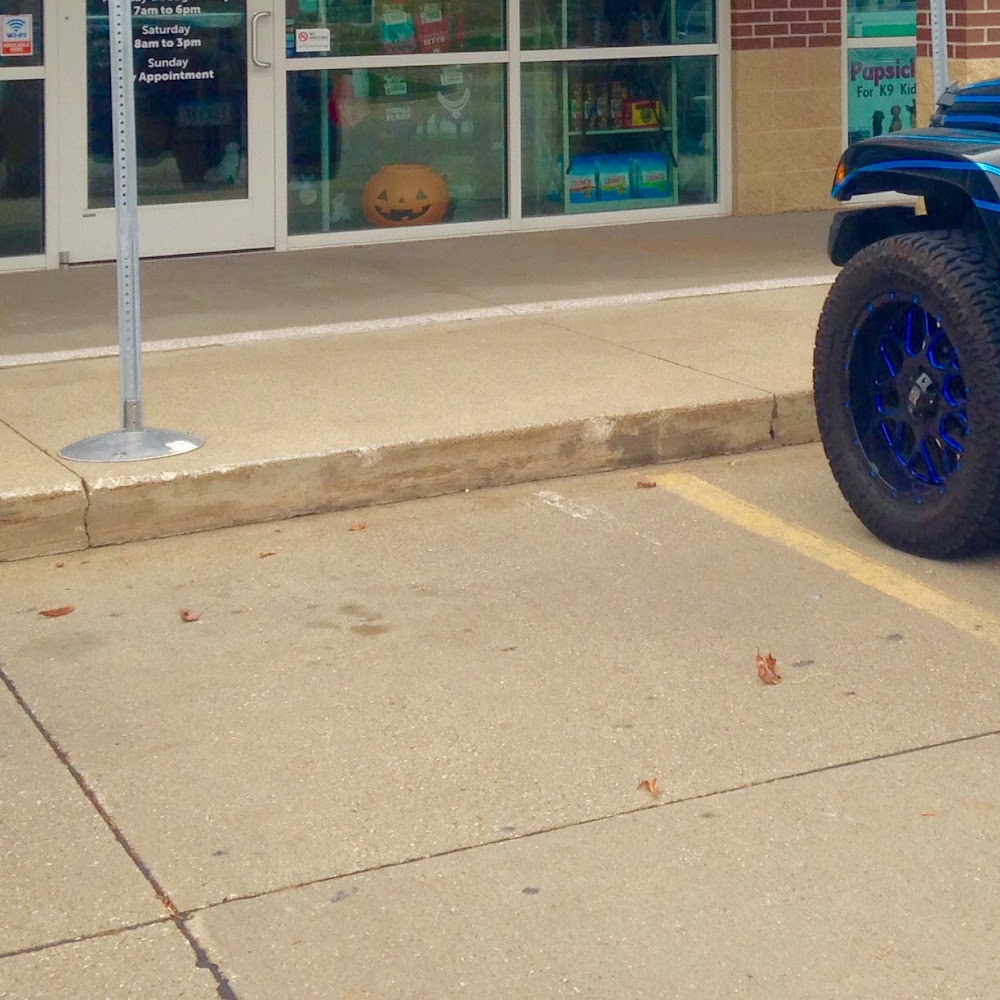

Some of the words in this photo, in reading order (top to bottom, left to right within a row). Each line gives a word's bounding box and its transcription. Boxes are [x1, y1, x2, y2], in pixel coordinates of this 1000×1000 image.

[133, 5, 158, 15] 7am
[160, 5, 173, 14] to
[175, 4, 201, 16] 6pm
[141, 24, 191, 36] Saturday
[133, 39, 160, 49] 8am
[161, 39, 174, 48] to
[176, 38, 202, 49] 3pm
[148, 57, 189, 69] Sunday
[138, 69, 214, 83] Appointment
[857, 86, 874, 98] For
[880, 84, 894, 97] K9
